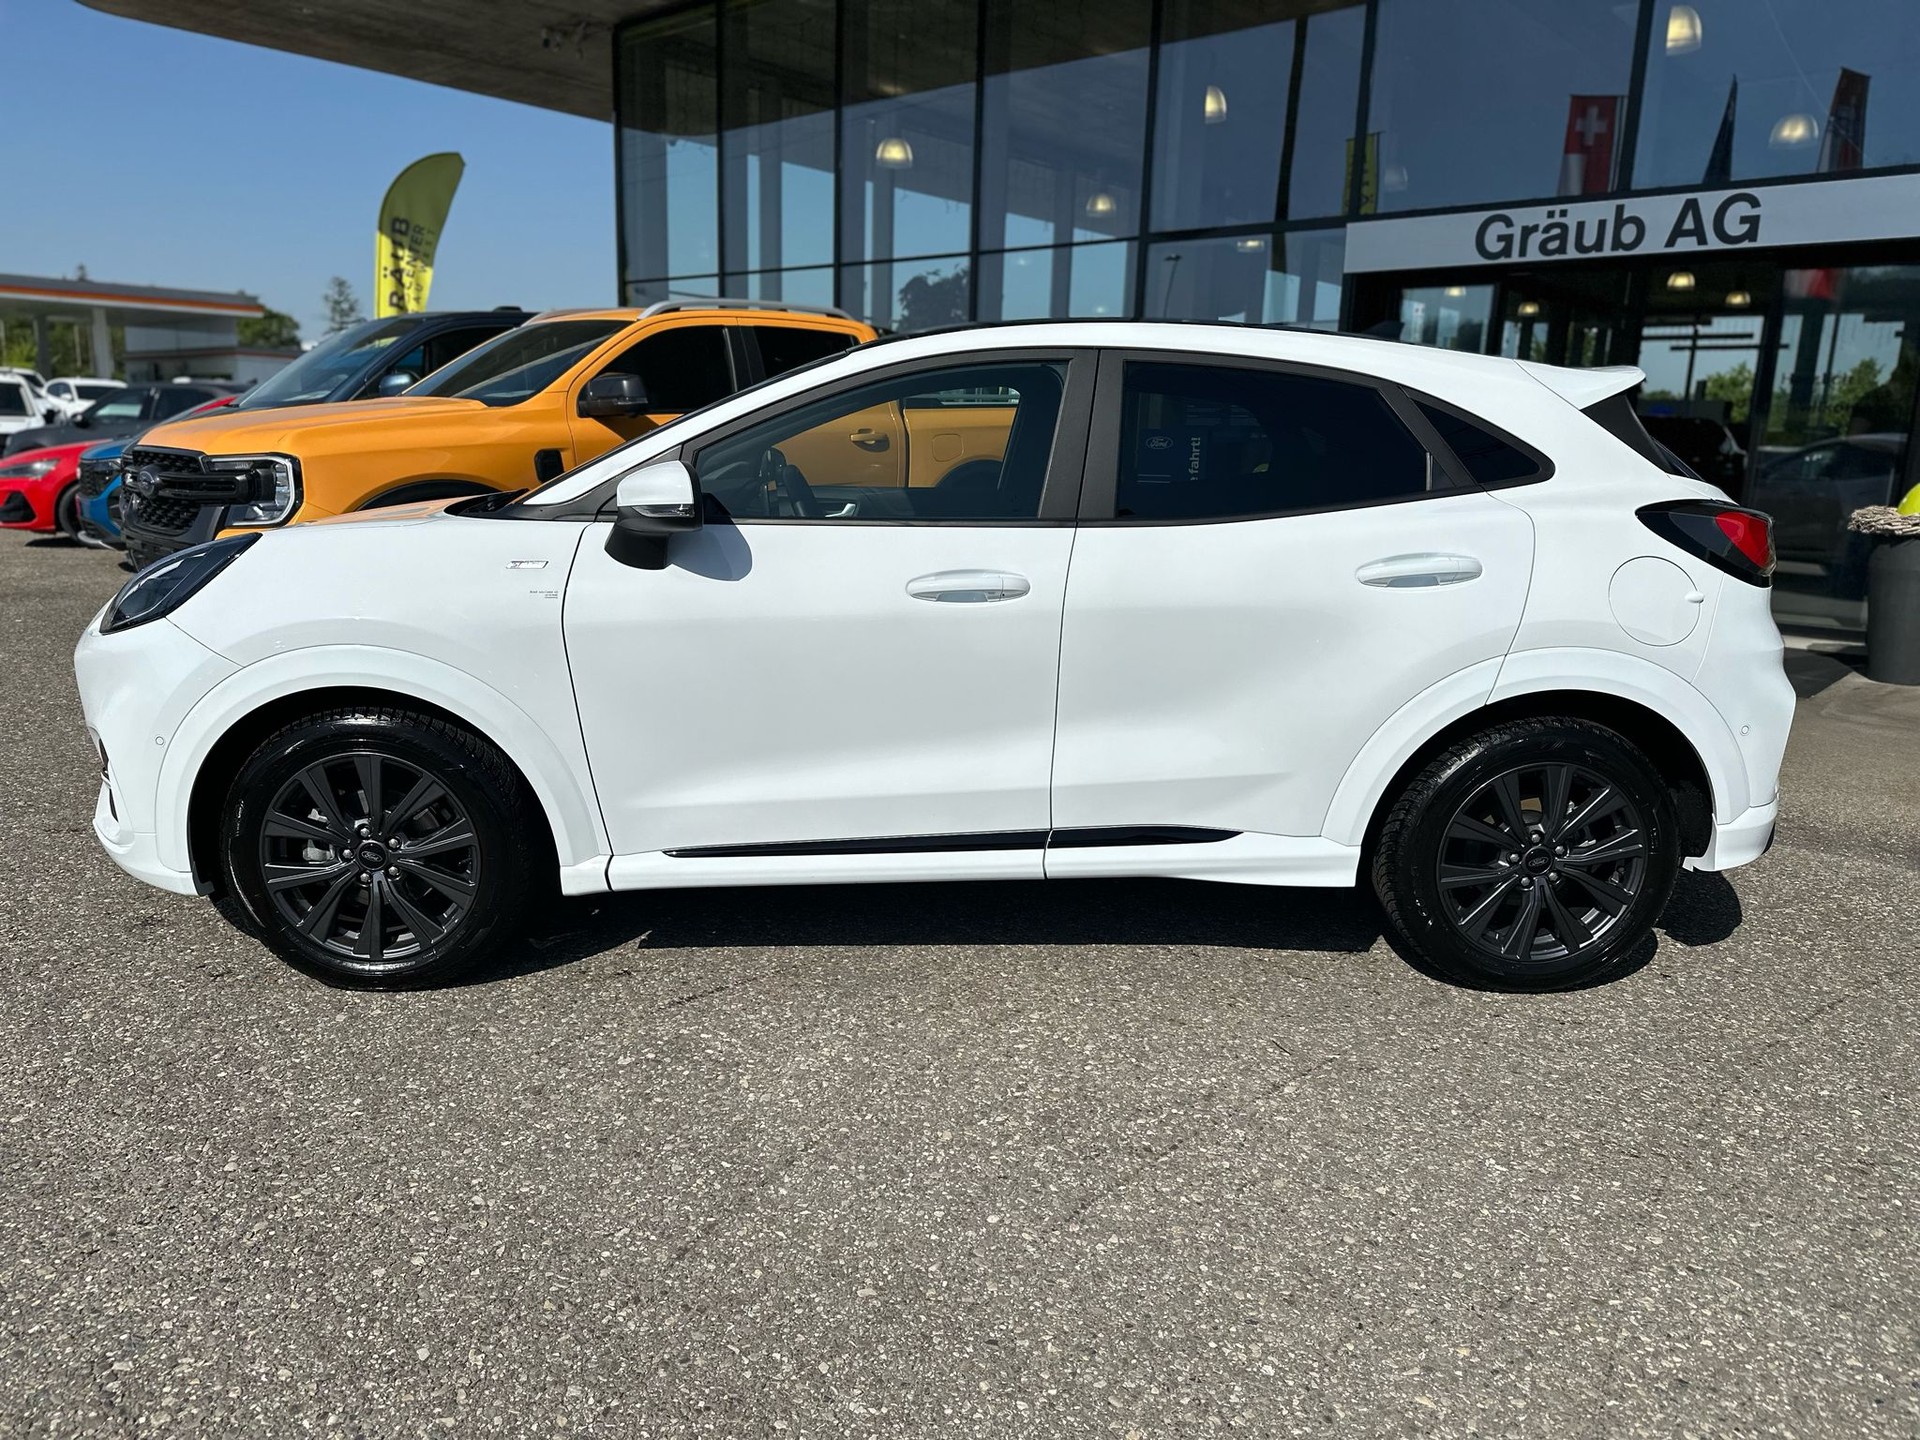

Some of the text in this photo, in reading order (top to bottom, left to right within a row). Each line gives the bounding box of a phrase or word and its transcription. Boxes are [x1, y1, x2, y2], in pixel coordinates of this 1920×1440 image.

[1475, 192, 1762, 261] Gräub AG
[383, 216, 410, 313] RÄUB
[1148, 437, 1170, 448] Ford
[1188, 436, 1201, 474] fahrt!
